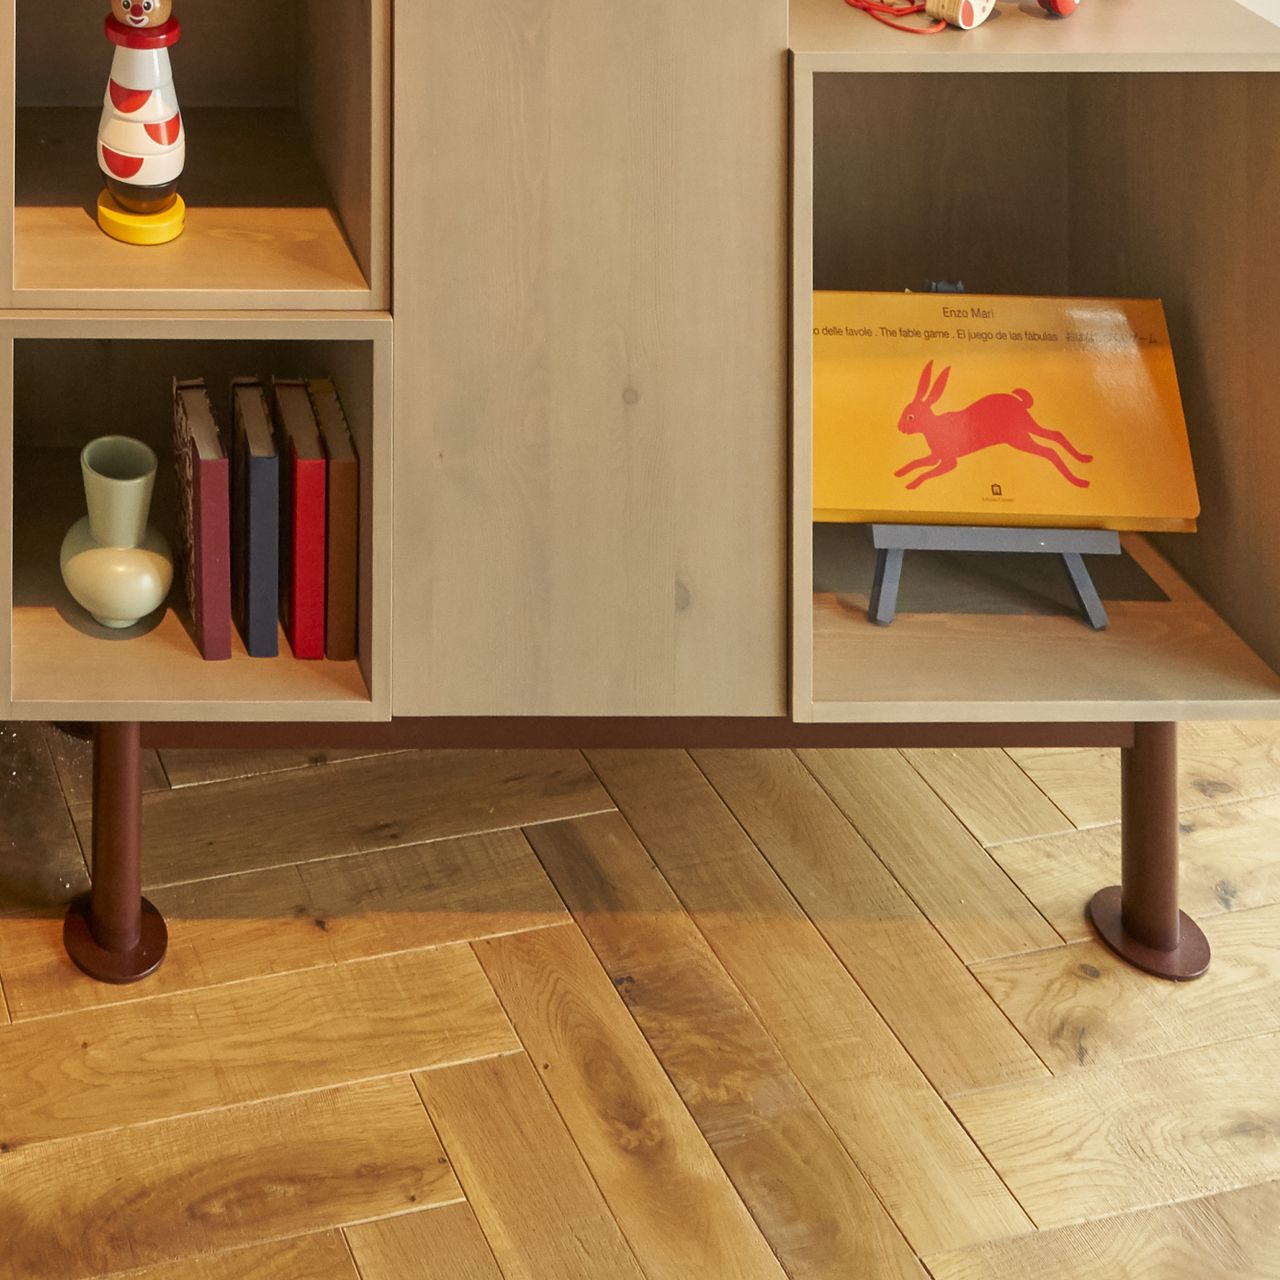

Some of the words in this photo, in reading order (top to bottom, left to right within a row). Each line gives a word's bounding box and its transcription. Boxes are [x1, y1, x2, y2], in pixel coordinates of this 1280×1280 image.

[942, 307, 969, 318] Enzo
[971, 307, 994, 319] Mari
[821, 326, 844, 336] delle
[845, 327, 872, 337] favole
[880, 327, 897, 337] The
[899, 327, 921, 338] fable
[924, 329, 950, 341] game
[956, 329, 966, 339] El
[968, 329, 994, 342] juego
[995, 329, 1008, 340] de
[1009, 330, 1023, 340] las
